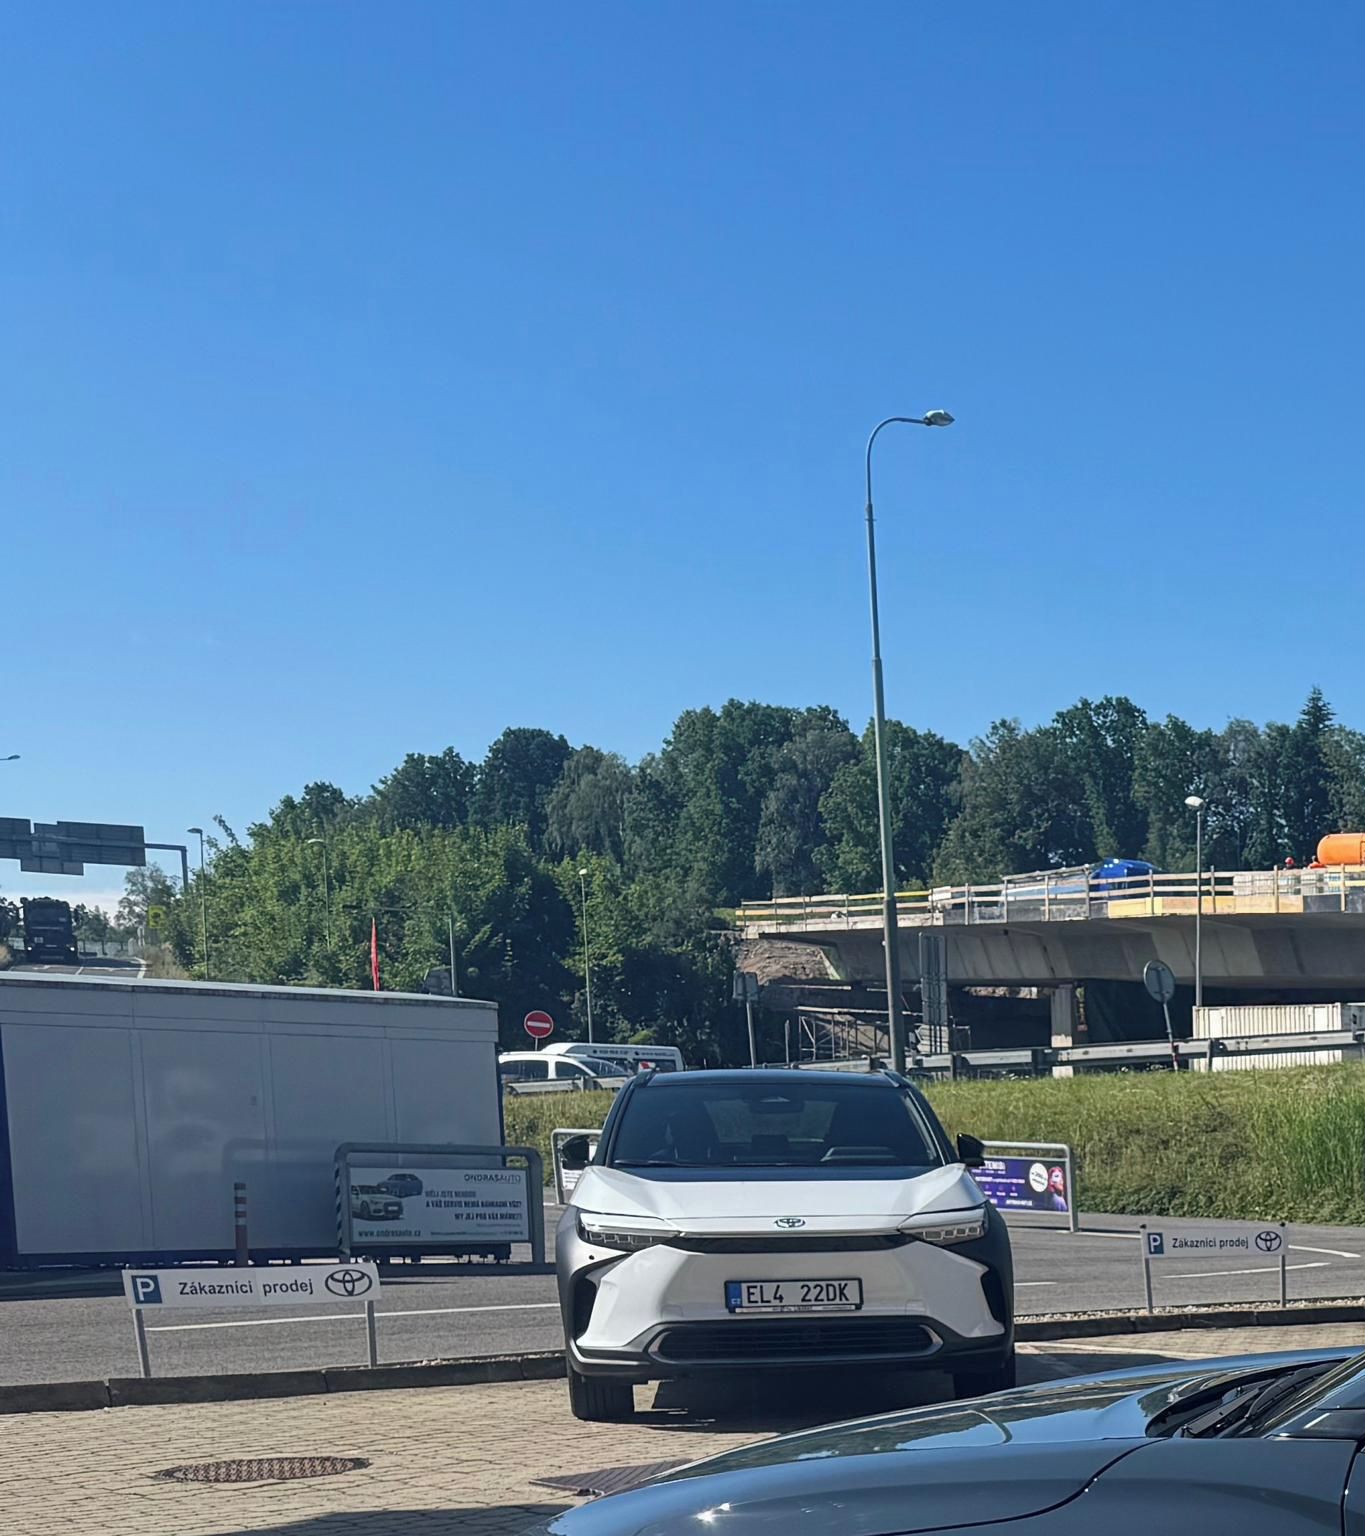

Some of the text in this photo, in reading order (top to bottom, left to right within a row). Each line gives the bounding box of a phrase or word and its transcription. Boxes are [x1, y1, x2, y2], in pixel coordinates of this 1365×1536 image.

[1219, 1237, 1249, 1250] prodej
[178, 1280, 253, 1296] Zákazníci
[262, 1278, 314, 1297] prodej
[746, 1284, 785, 1304] EL4
[800, 1282, 850, 1303] 22DK
